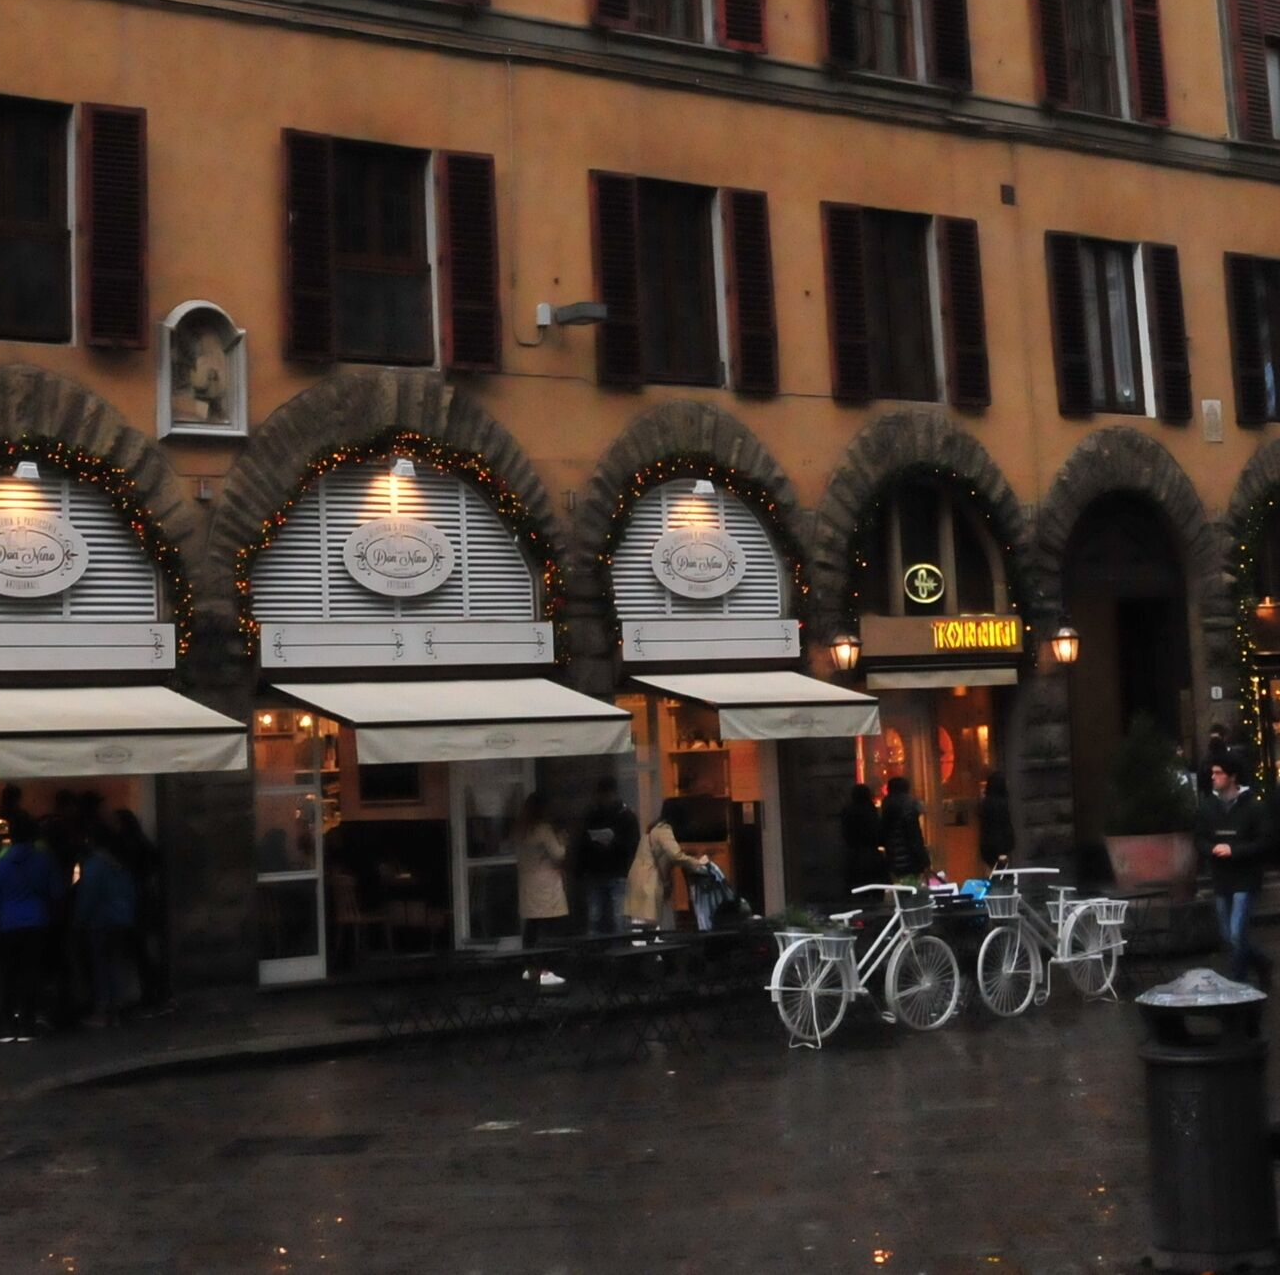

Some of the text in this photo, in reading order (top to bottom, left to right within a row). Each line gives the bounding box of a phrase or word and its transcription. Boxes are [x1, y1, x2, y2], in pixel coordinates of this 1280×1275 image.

[21, 545, 56, 565] Nino
[373, 548, 428, 566] Don Nino
